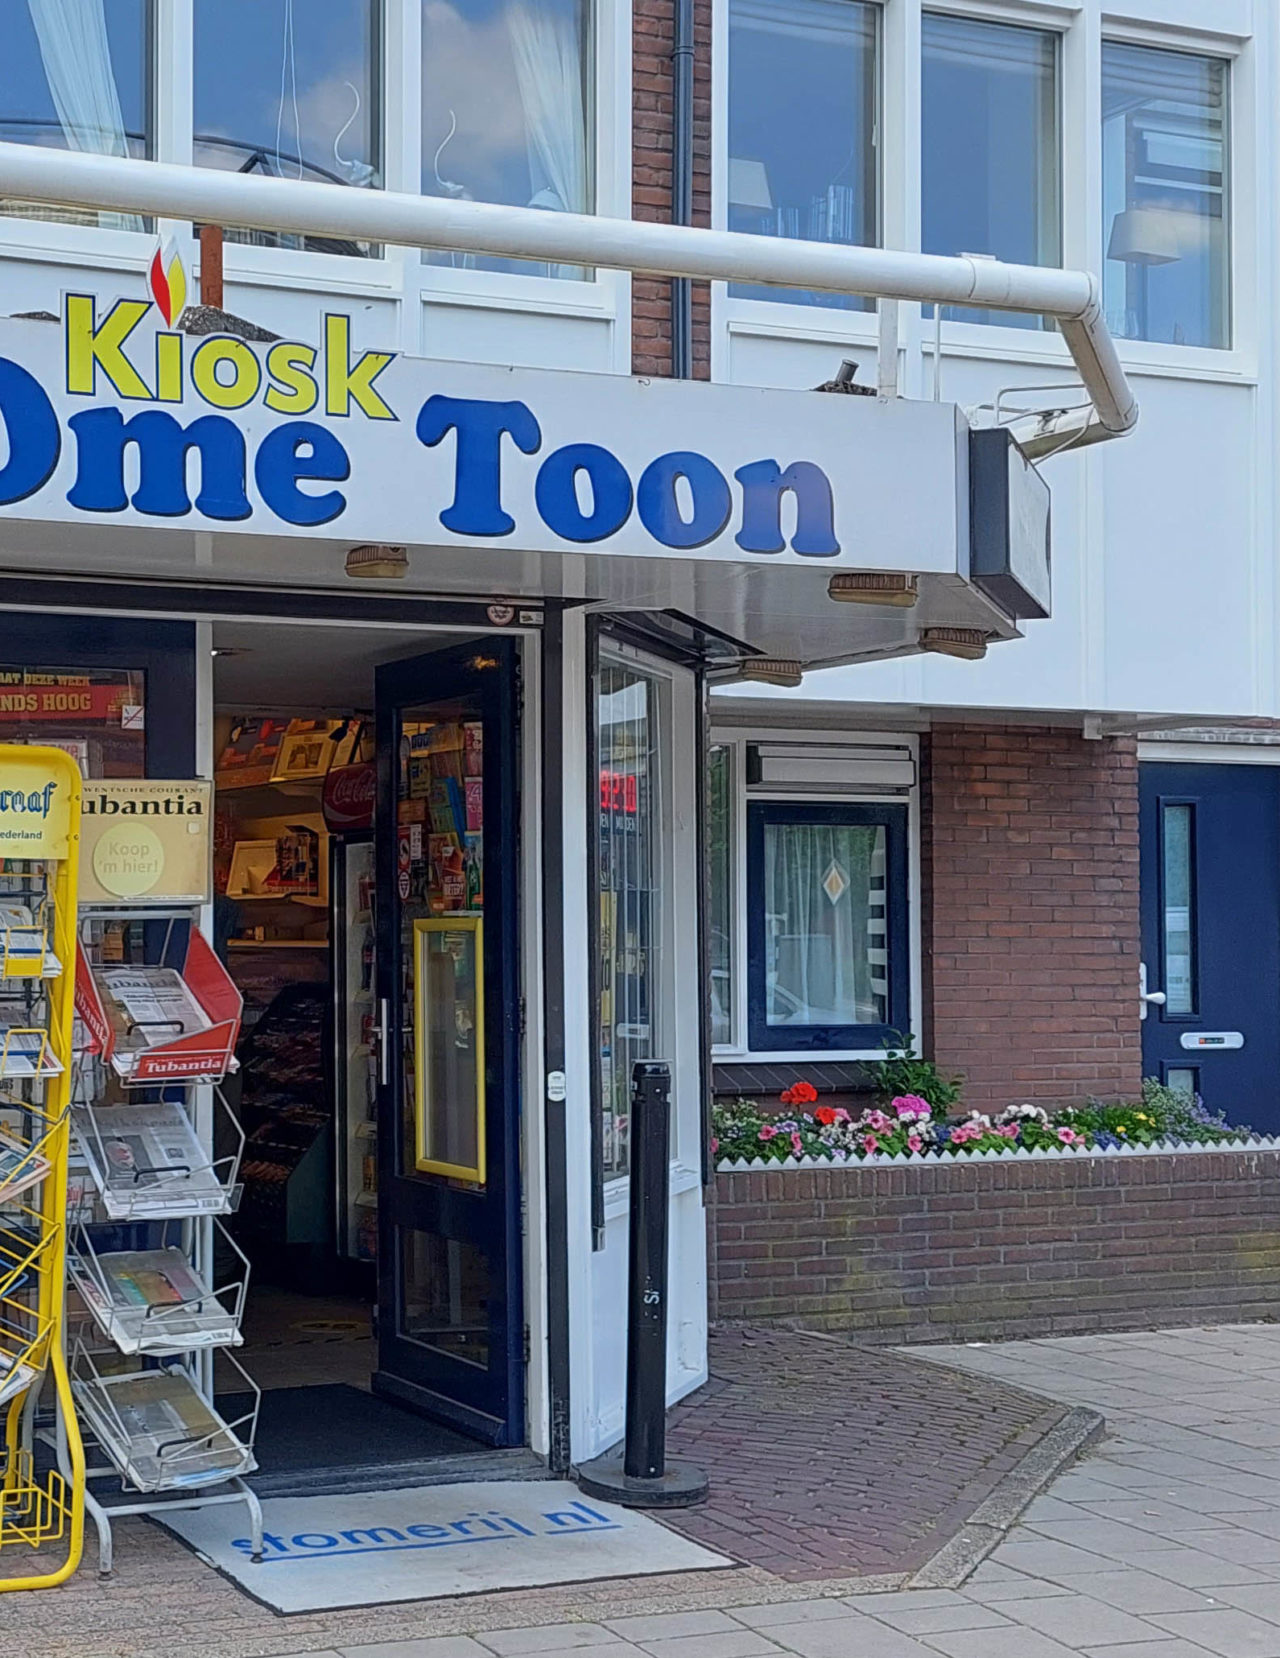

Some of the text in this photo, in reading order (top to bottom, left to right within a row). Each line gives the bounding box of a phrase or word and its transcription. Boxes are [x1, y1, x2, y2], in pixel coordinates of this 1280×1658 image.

[63, 291, 400, 422] Kiosk
[415, 393, 842, 559] Toon
[24, 673, 55, 686] DEZE
[42, 692, 92, 712] HOOG
[108, 841, 150, 859] Koop
[122, 859, 158, 874] hier!
[145, 1058, 221, 1073] Tubantia
